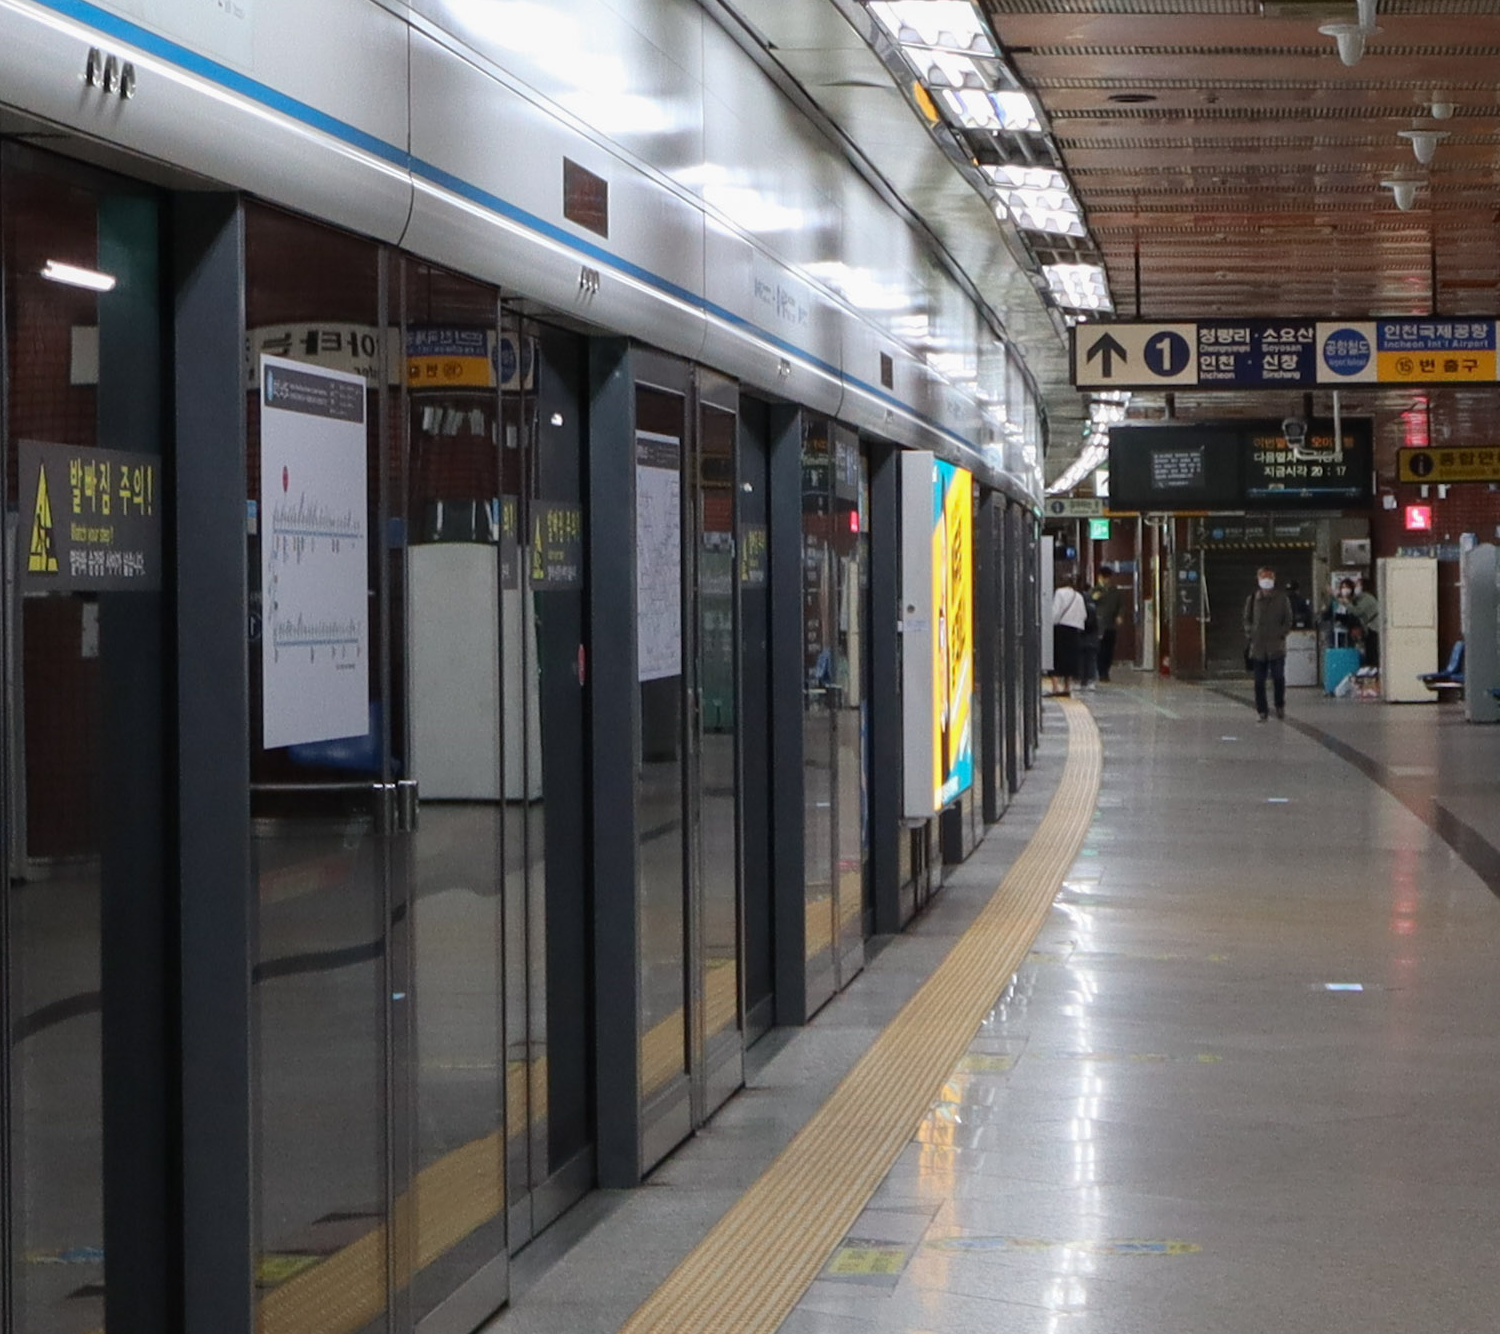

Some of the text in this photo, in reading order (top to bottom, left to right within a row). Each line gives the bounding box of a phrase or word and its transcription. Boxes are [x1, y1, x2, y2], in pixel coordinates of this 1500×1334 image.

[1262, 327, 1314, 343] 소요산
[1384, 323, 1488, 339] 인천국제공항
[1384, 340, 1423, 349] Incheon
[1453, 339, 1489, 349] Airport
[1155, 339, 1176, 371] 1
[1200, 355, 1235, 371] 인천
[69, 457, 153, 516] 발빠짐 주의!
